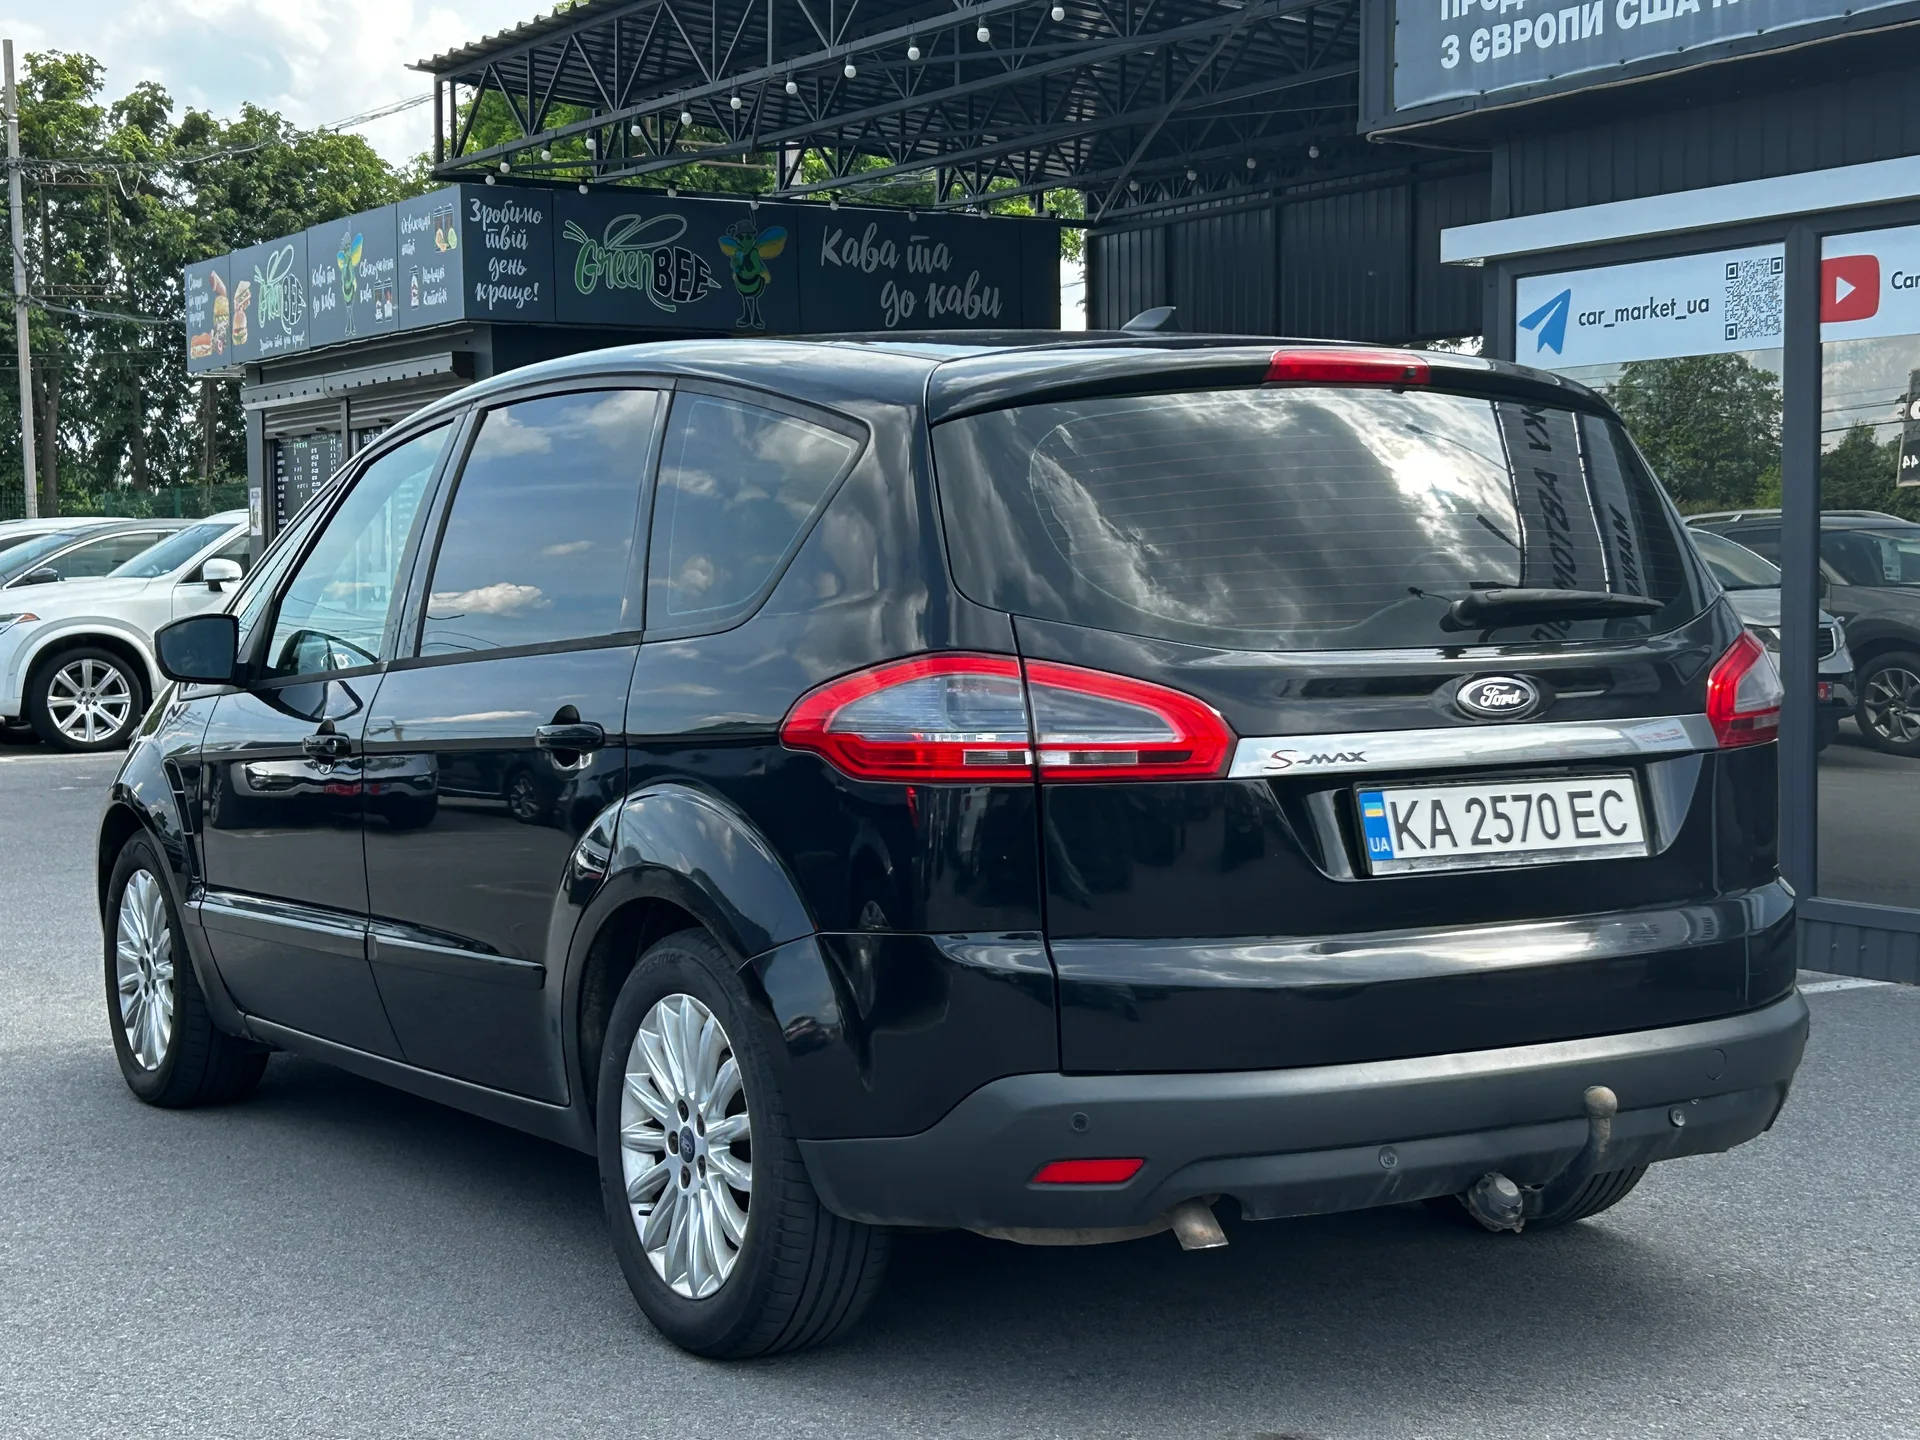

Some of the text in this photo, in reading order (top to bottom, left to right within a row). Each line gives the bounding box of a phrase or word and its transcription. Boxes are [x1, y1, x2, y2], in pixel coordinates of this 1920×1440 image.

[1440, 34, 1460, 69] З
[1469, 0, 1604, 63] ЄВРОПИ
[470, 198, 543, 231] Зробимо
[486, 224, 529, 251] твій
[820, 222, 953, 274] Кава та
[488, 256, 528, 282] день
[1891, 270, 1920, 290] Car
[475, 282, 540, 311] краще!
[880, 270, 1003, 328] до кави
[1578, 296, 1710, 328] car_market_ua
[1479, 684, 1522, 707] Ford
[1390, 789, 1628, 851] KA 2570 EC
[1369, 838, 1391, 853] UA
